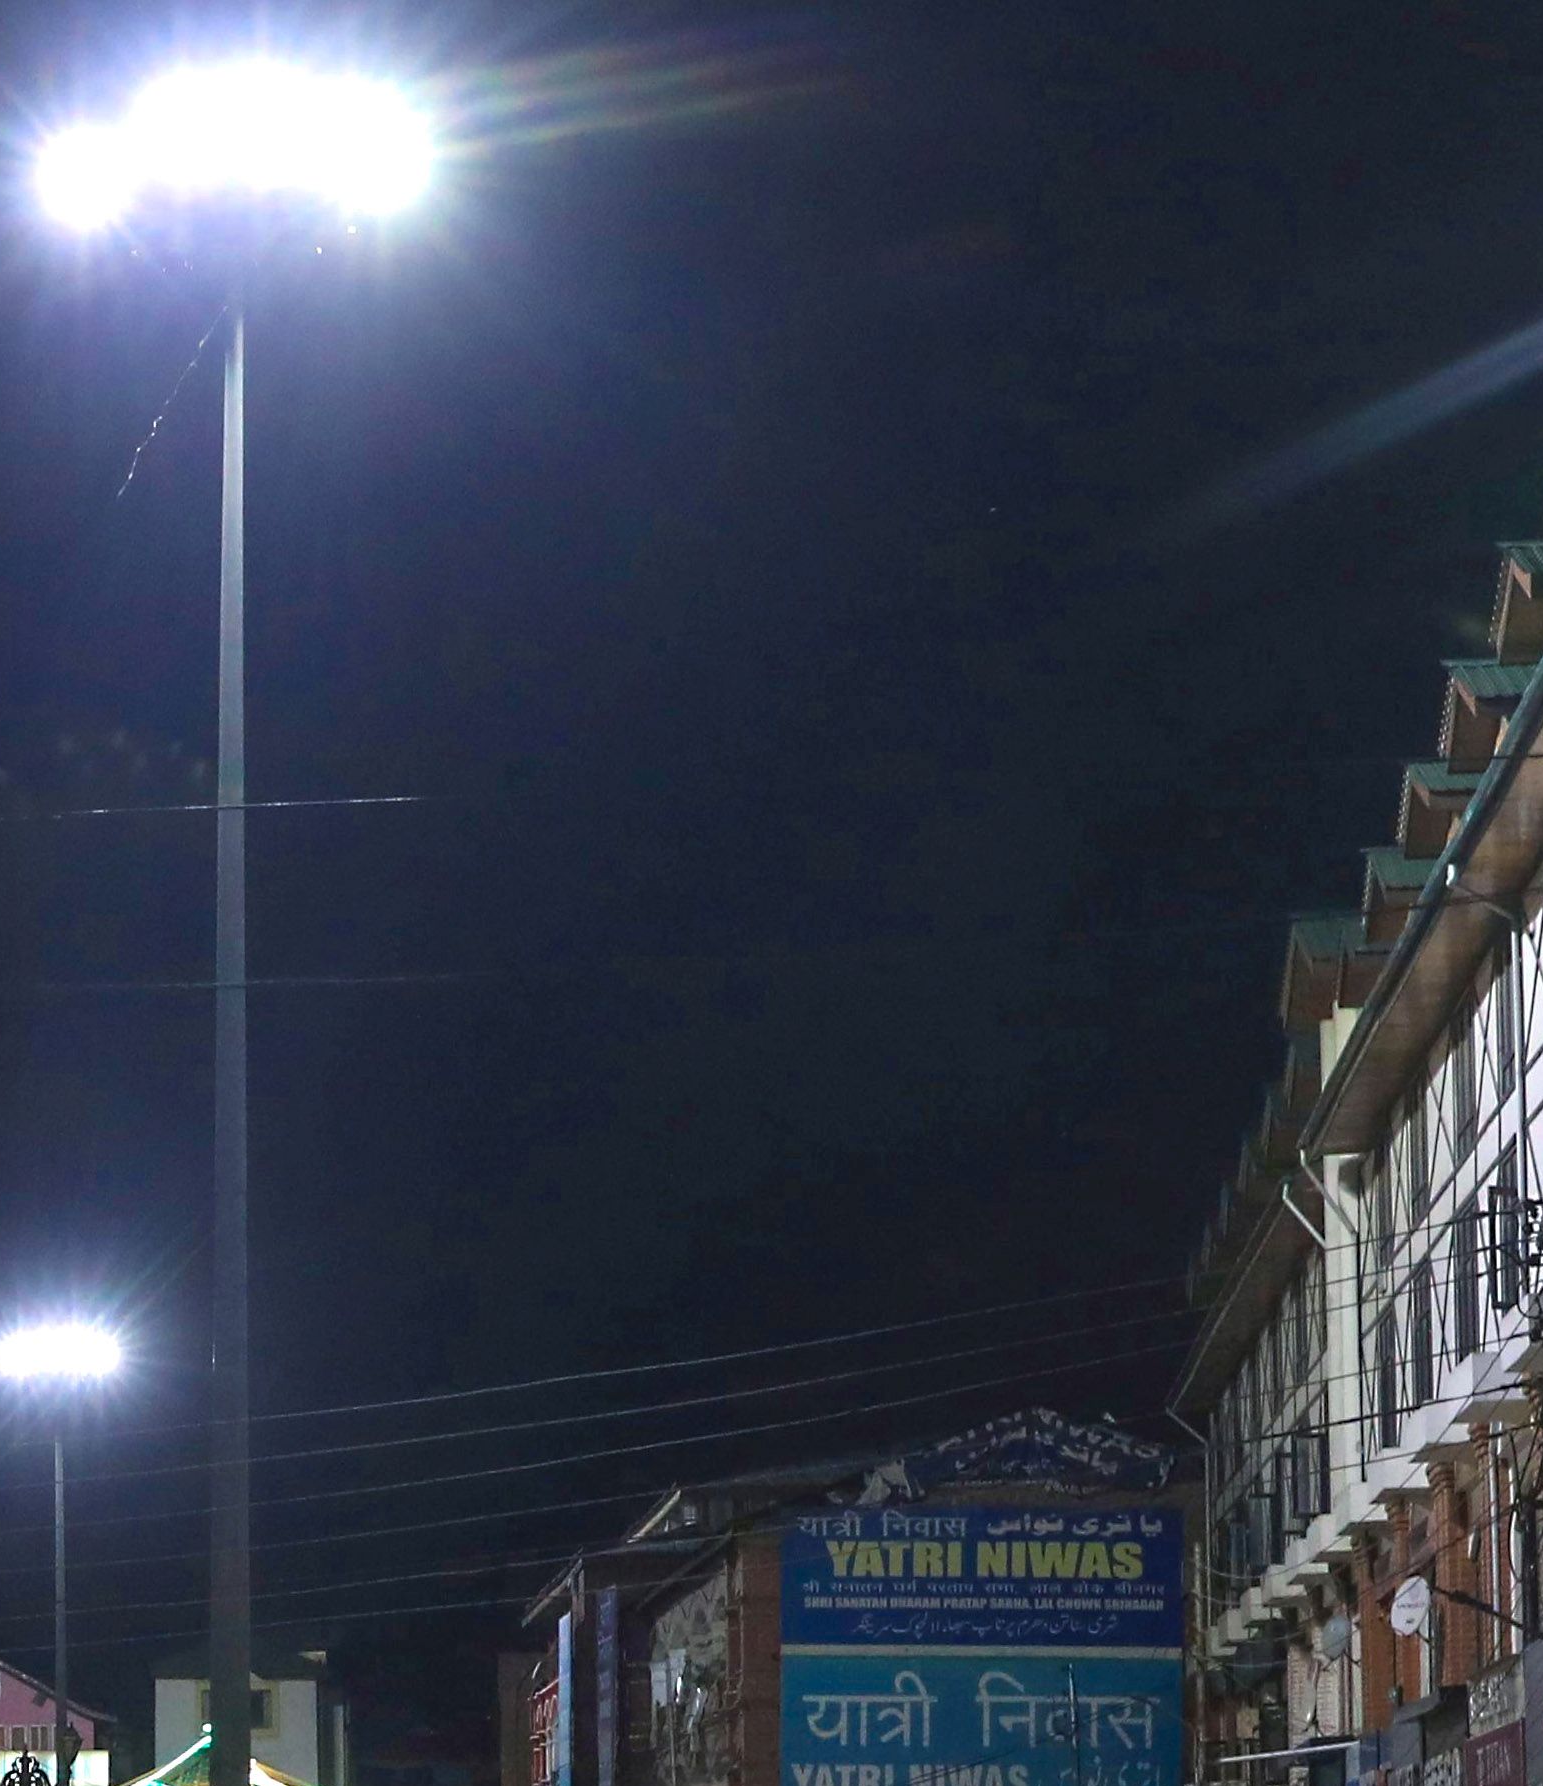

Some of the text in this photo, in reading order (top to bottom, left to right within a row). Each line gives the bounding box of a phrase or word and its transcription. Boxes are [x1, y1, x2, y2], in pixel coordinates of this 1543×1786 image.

[881, 1508, 967, 1537] निवास
[826, 1541, 1144, 1580] YATRI NIWAS
[804, 1597, 833, 1609] SHRI
[835, 1597, 887, 1609] SANATAN
[890, 1597, 941, 1609] DHARAM
[943, 1597, 987, 1610] PRATAP
[1056, 1598, 1101, 1611] CHOWK
[1104, 1598, 1164, 1611] SRINAGAR
[802, 1670, 939, 1747] यात्री
